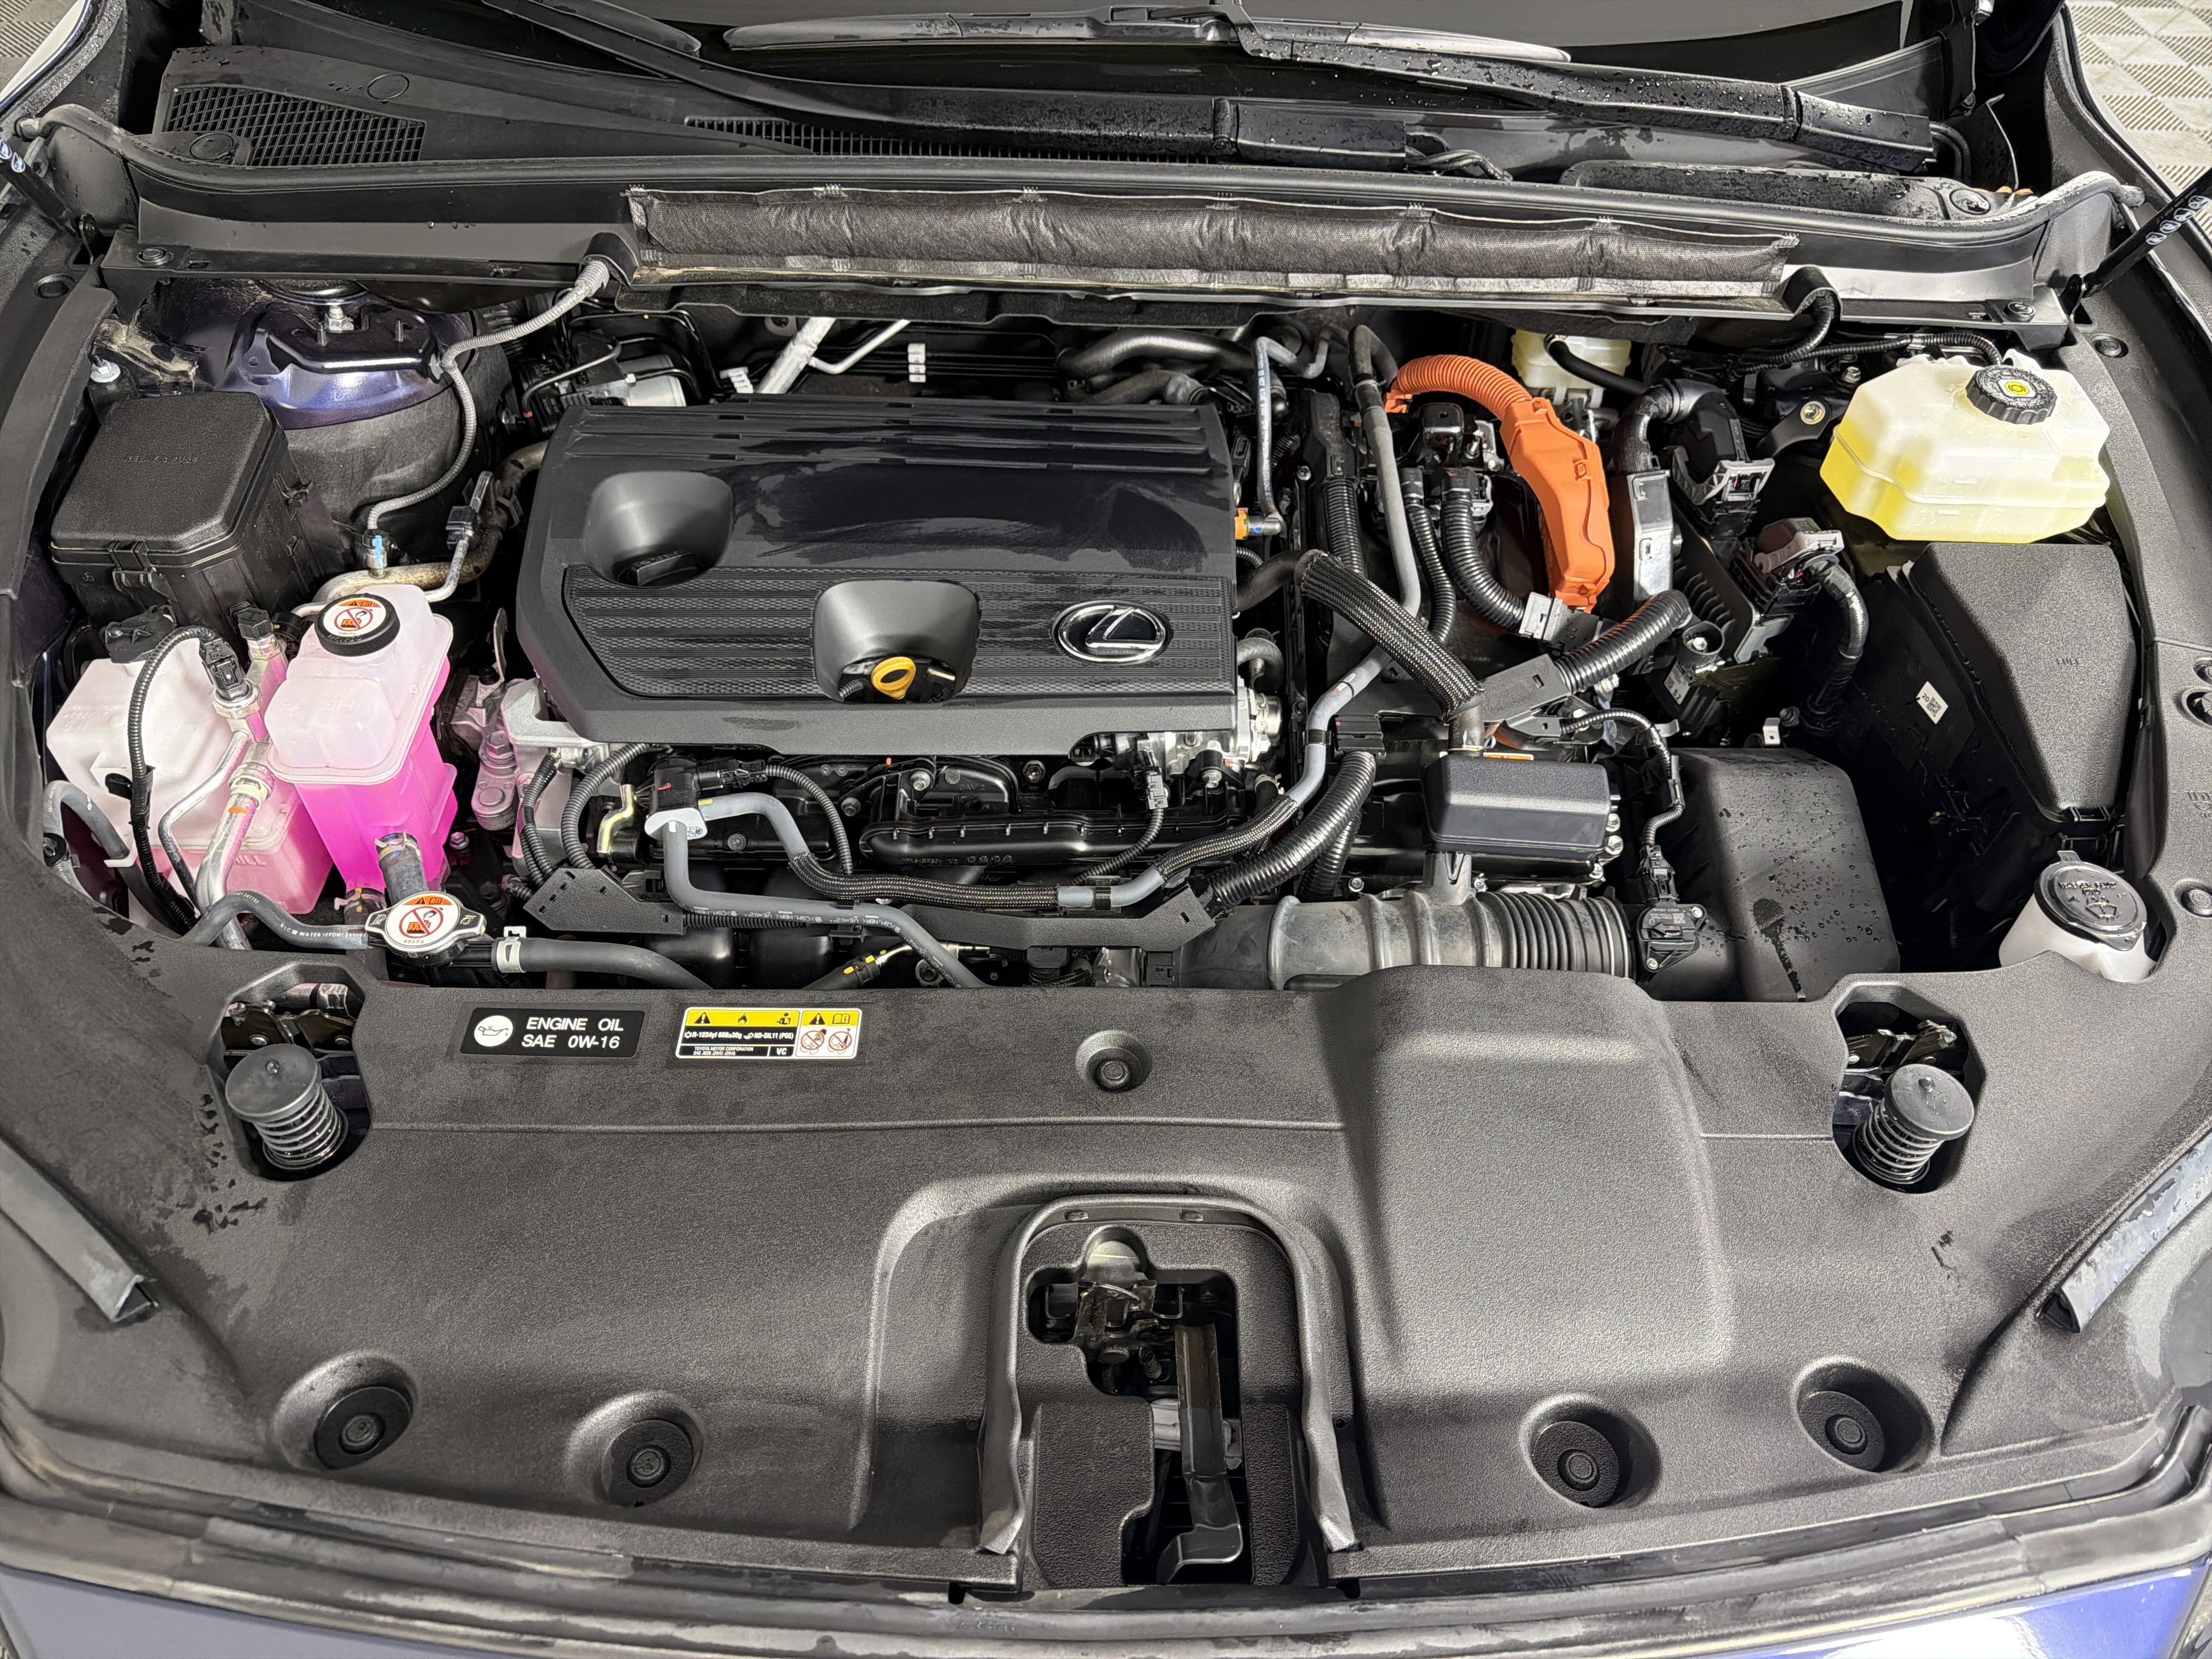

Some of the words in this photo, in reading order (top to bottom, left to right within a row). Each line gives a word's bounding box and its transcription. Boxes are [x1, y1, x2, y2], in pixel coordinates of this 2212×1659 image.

[1922, 693, 1930, 703] 20
[526, 1017, 588, 1030] ENGINE
[598, 1018, 624, 1031] OIL
[521, 1034, 557, 1047] SAE
[568, 1035, 620, 1049] 0W-16
[779, 1032, 794, 1040] (POE)
